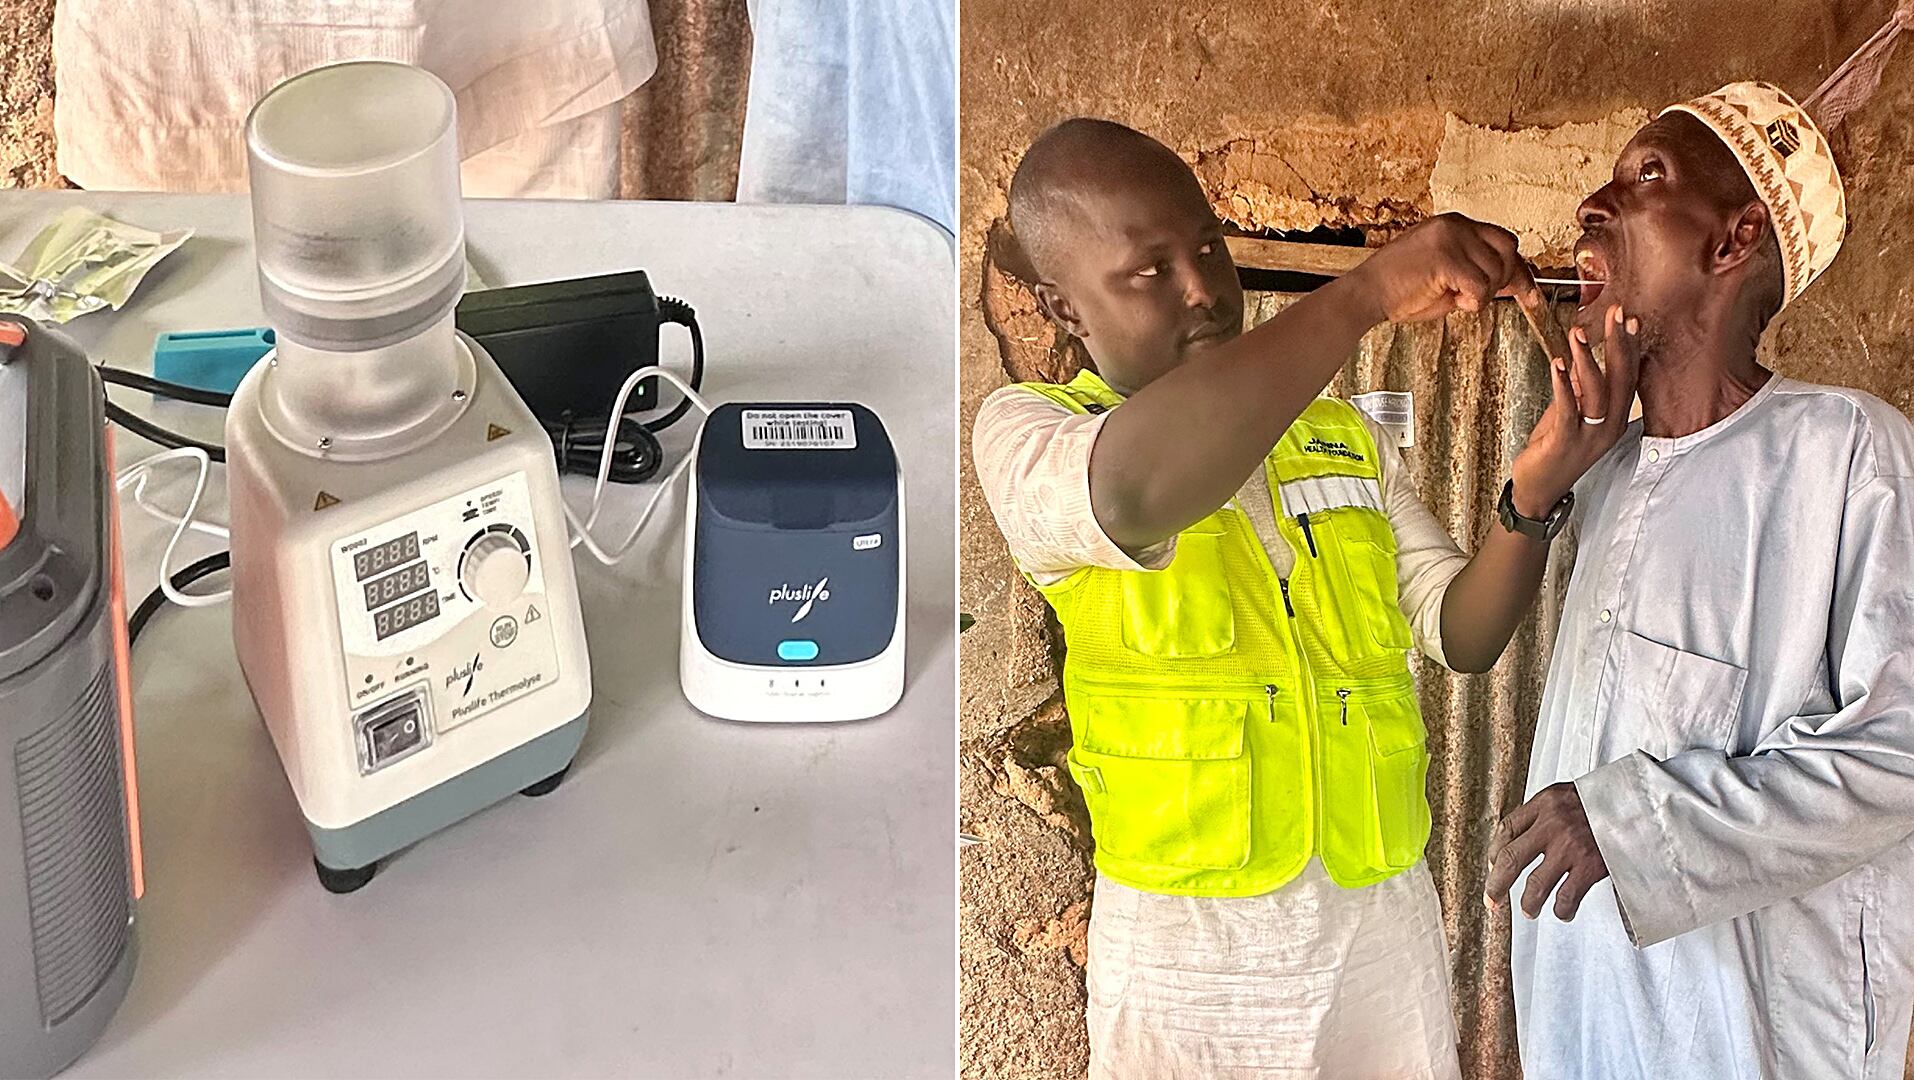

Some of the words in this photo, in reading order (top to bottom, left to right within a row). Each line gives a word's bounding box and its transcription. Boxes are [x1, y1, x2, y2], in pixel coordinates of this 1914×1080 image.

[1327, 448, 1365, 462] FOUNDATION
[769, 577, 830, 623] pluslife
[446, 652, 483, 697] pluslife
[452, 697, 488, 719] Pluslife
[488, 673, 542, 702] Thermolyse
